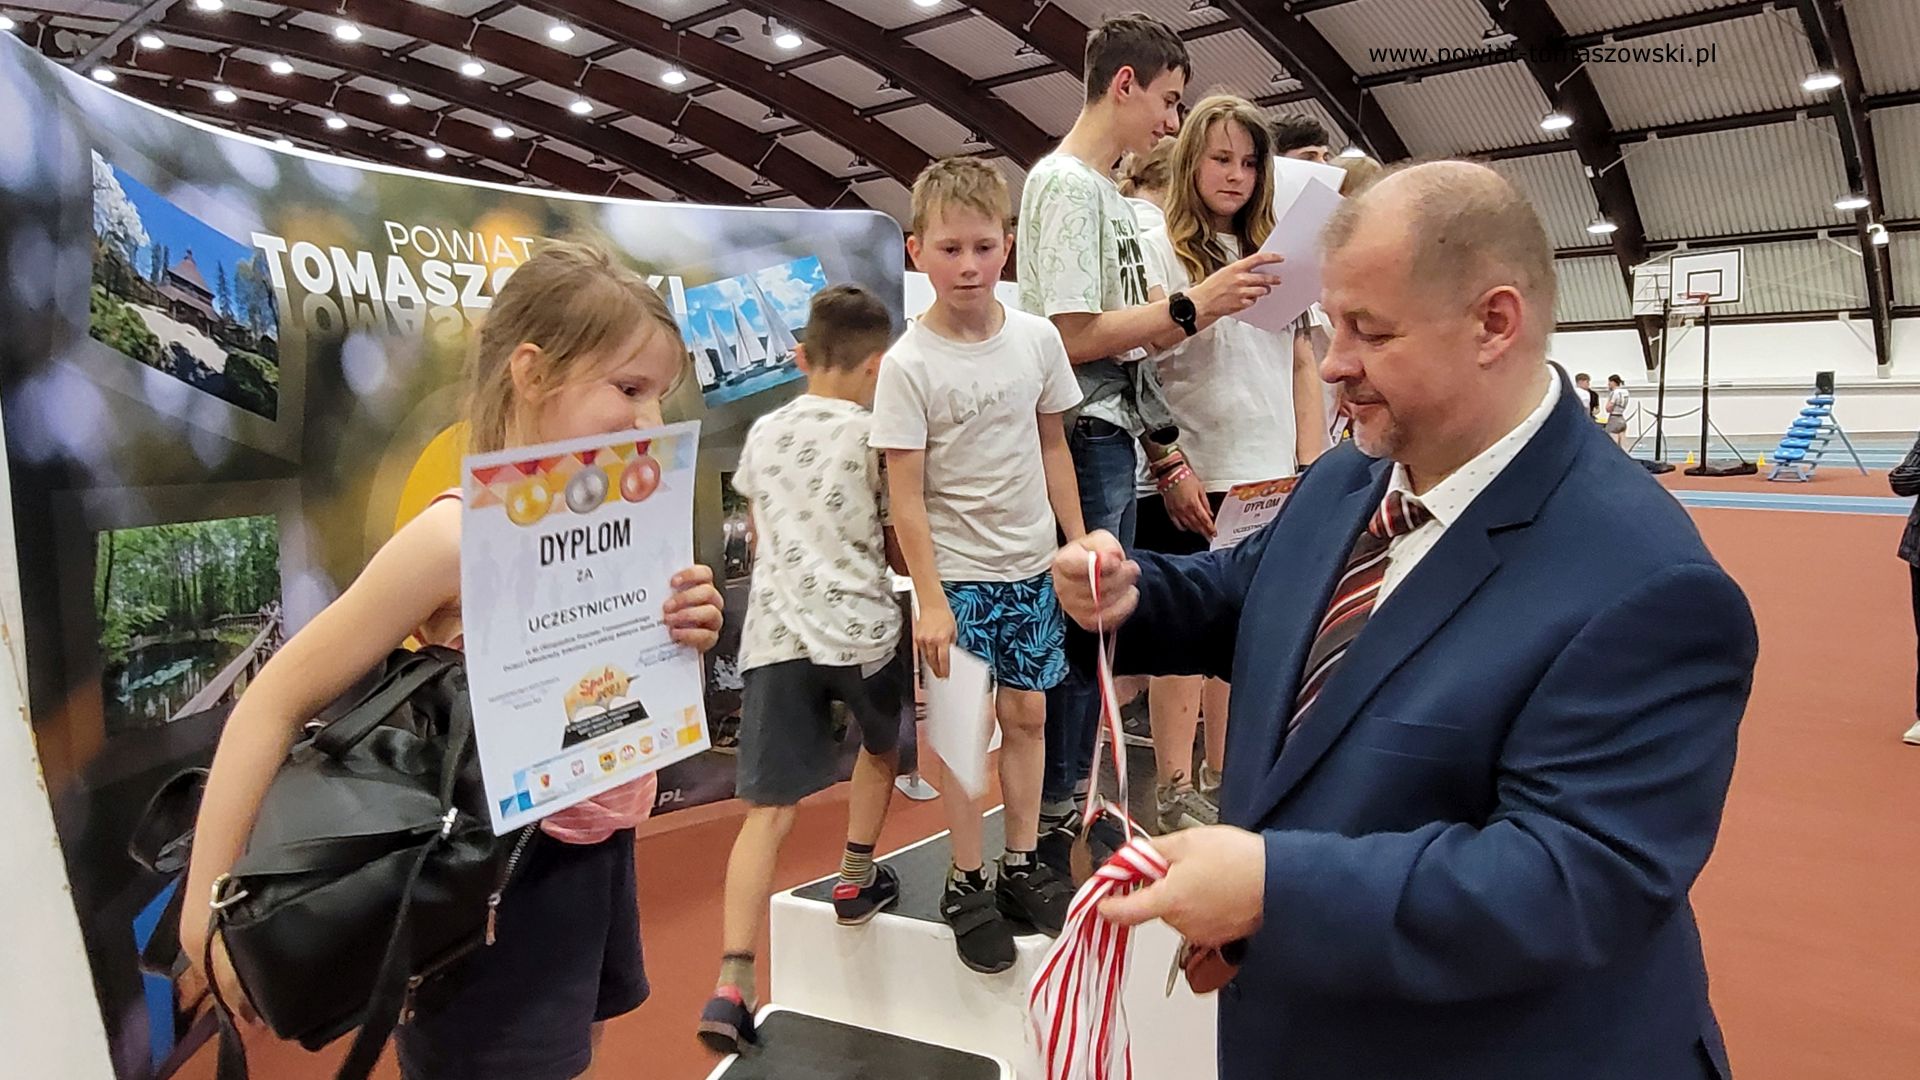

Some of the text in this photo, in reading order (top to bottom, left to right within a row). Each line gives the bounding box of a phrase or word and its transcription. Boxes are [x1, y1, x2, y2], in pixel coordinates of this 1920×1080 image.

[384, 220, 534, 265] POWIAT
[1243, 497, 1281, 513] DYPLOM
[539, 517, 632, 566] DYPLOM
[576, 569, 594, 583] ZA
[527, 588, 648, 633] UCZESTNICTWO
